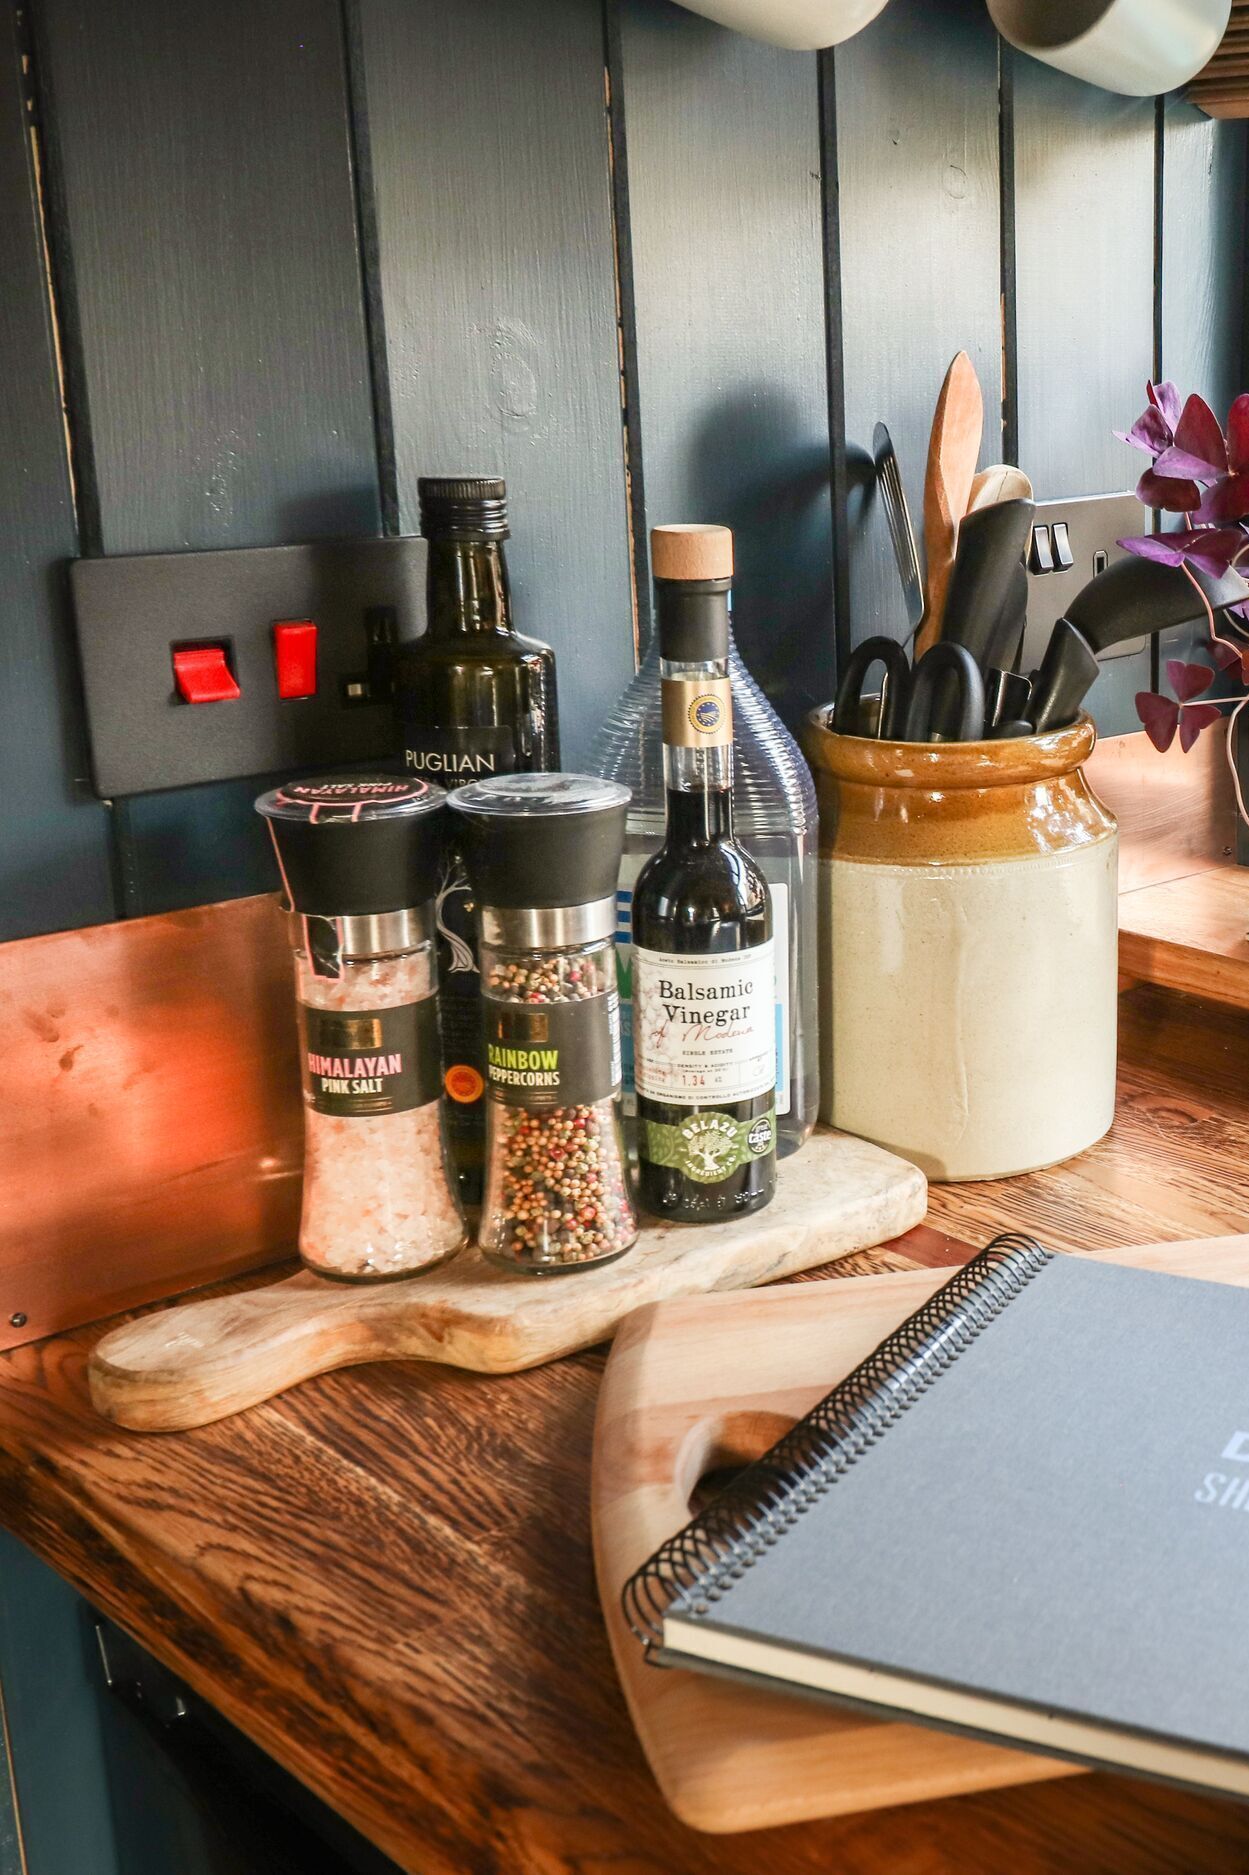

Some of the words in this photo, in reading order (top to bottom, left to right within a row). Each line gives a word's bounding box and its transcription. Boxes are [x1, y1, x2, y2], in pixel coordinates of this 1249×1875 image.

[405, 749, 495, 772] PUGLIAN
[294, 785, 409, 795] HIMALAYAN
[659, 979, 753, 1000] Balsamic
[662, 1004, 750, 1027] Vinegar
[308, 1053, 402, 1078] HIMALAYAN
[488, 1044, 559, 1070] RAINBOW
[321, 1077, 350, 1094] PINK
[352, 1078, 383, 1094] SALT
[489, 1064, 560, 1086] PEPPERCORNS
[682, 1075, 705, 1086] 1.34
[682, 1120, 737, 1139] BELAZU
